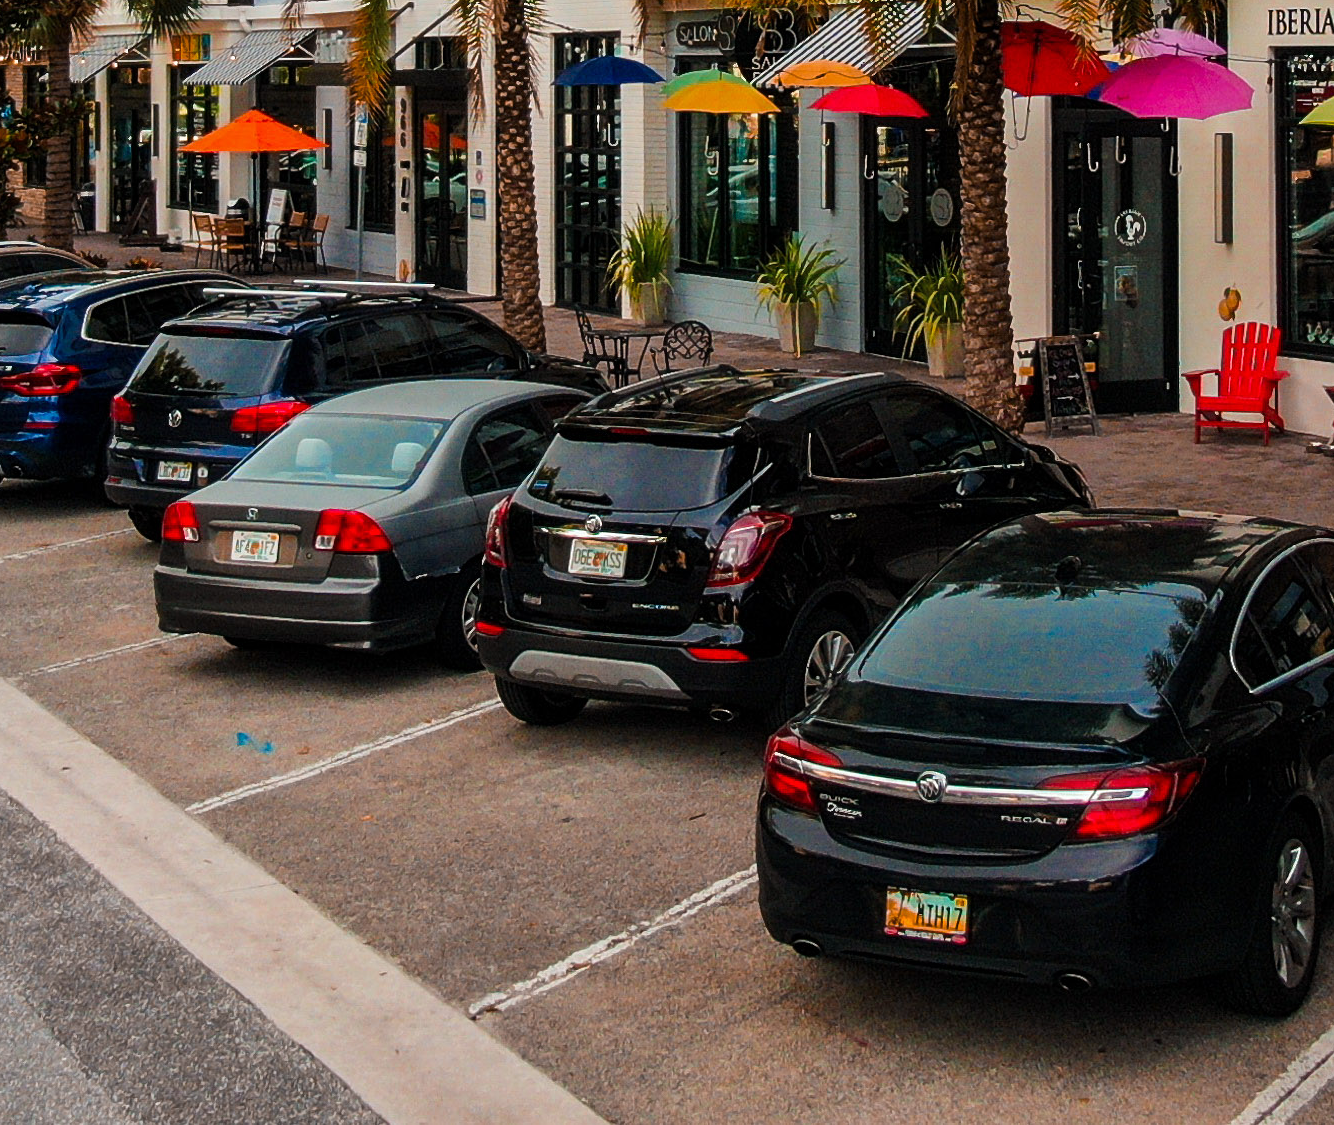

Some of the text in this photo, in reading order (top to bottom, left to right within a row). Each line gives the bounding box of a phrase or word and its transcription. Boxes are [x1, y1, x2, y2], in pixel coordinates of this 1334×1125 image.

[679, 24, 716, 43] SALON
[819, 793, 859, 806] BUICK
[1000, 815, 1052, 825] REGAL
